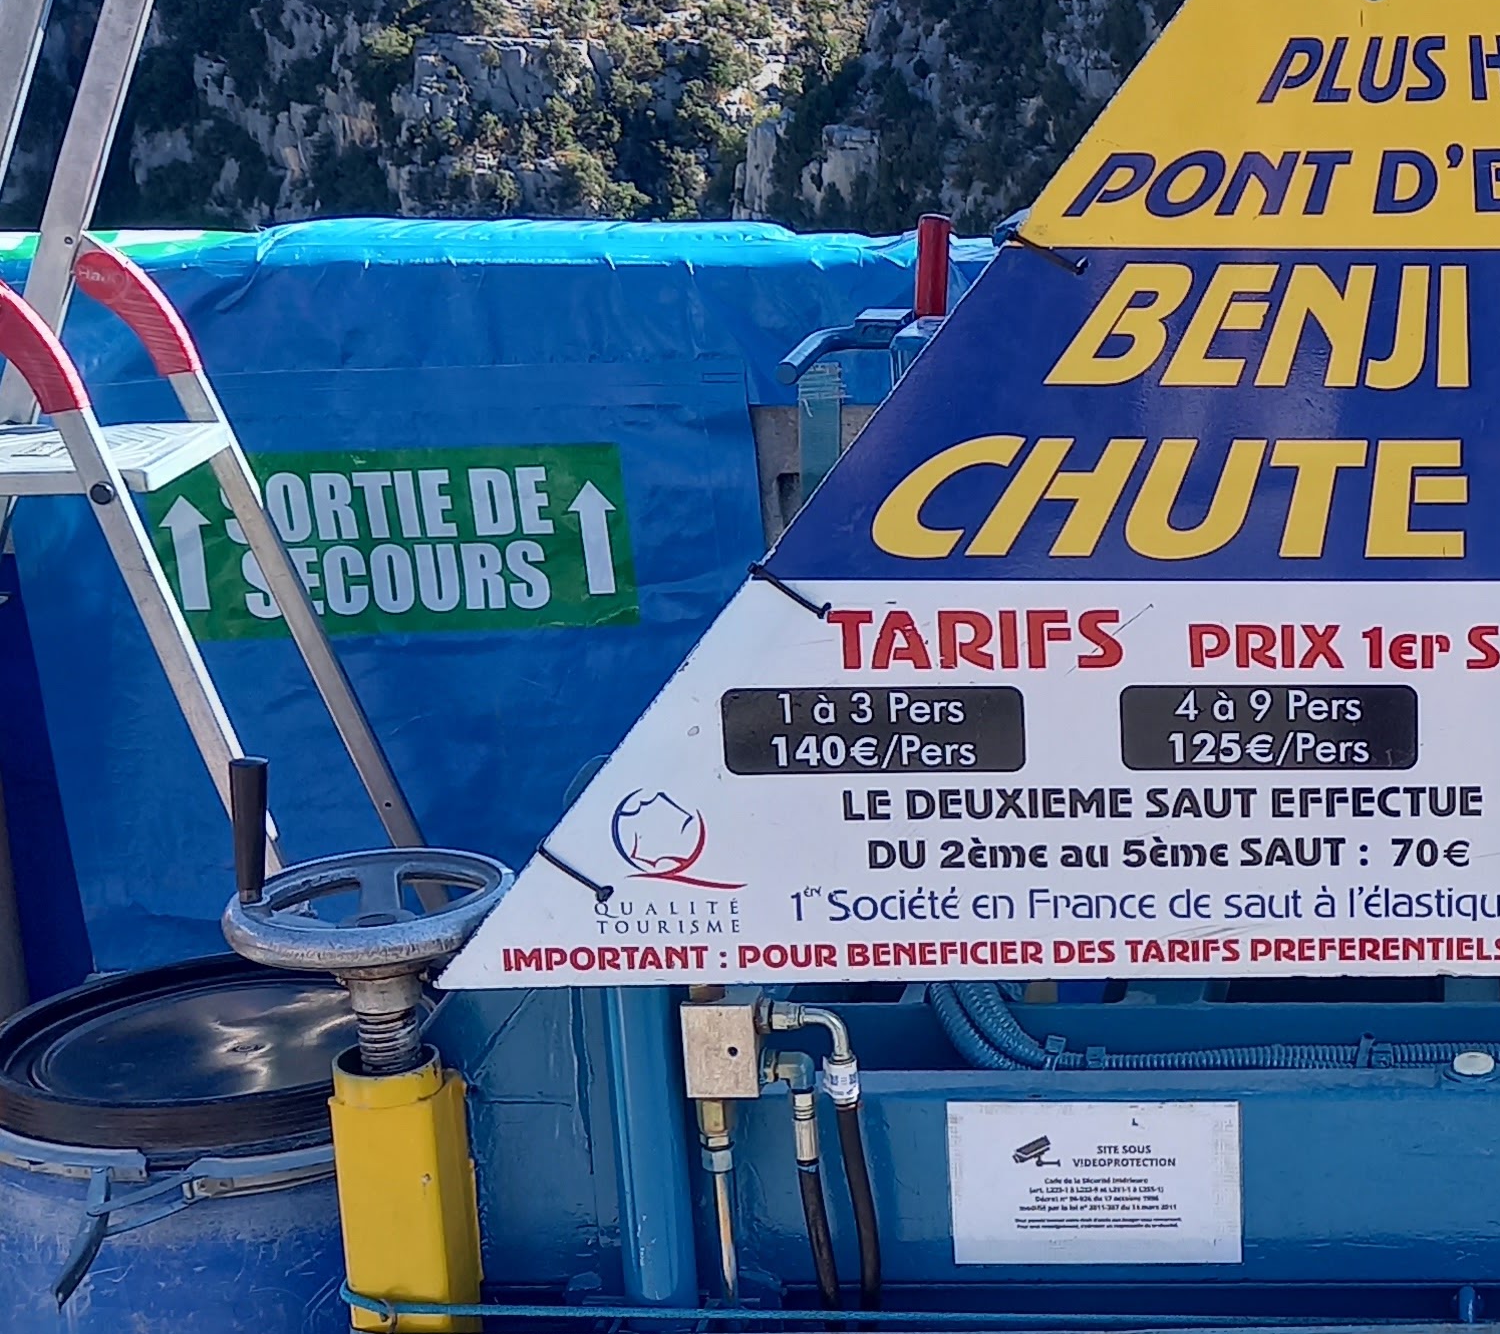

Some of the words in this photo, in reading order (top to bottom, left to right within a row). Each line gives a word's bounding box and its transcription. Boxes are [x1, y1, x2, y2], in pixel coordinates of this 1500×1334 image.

[1257, 35, 1447, 104] PLUS
[1063, 149, 1353, 217] PONT
[1043, 261, 1470, 388] BENJI
[469, 465, 554, 538] DE
[872, 433, 1468, 560] CHUTE
[827, 609, 1124, 671] TARIFS
[1188, 623, 1345, 670] PRIX
[1362, 626, 1451, 670] 1er
[776, 692, 793, 725] 1
[813, 693, 836, 724] à
[850, 692, 875, 725] 3
[889, 692, 965, 724] Pers
[1174, 689, 1199, 722] 4
[1212, 688, 1235, 721] à
[1249, 689, 1273, 721] 9
[1287, 689, 1362, 721] Pers
[770, 733, 977, 770] 140€/Pers
[1167, 731, 1370, 767] 125€/Pers
[842, 789, 892, 821] LE
[906, 788, 1133, 820] DEUXIEME
[1145, 787, 1258, 820] SAUT
[1272, 786, 1483, 818] EFFECTUE
[867, 838, 926, 870] DU
[940, 835, 1047, 870] 2ème
[1060, 844, 1109, 868] au
[1122, 835, 1227, 868] 5ème
[1240, 836, 1346, 868] SAUT
[1390, 837, 1470, 868] 70€
[594, 897, 740, 919] QUALITÉ
[827, 885, 960, 921] Société
[972, 894, 1014, 920] en
[1029, 888, 1157, 919] France
[1168, 887, 1210, 919] de
[1223, 889, 1303, 919] saut
[1314, 884, 1336, 919] à
[596, 919, 741, 934] TOURISME
[502, 944, 709, 972] IMPORTANT
[738, 944, 838, 969] POUR
[848, 940, 1043, 967] BENEFICIER
[1053, 939, 1116, 965] DES
[1125, 938, 1241, 965] TARIFS
[1072, 1157, 1176, 1168] VIDEOPROTECTION
[1096, 1144, 1119, 1155] SITE
[1122, 1144, 1152, 1155] SOUS
